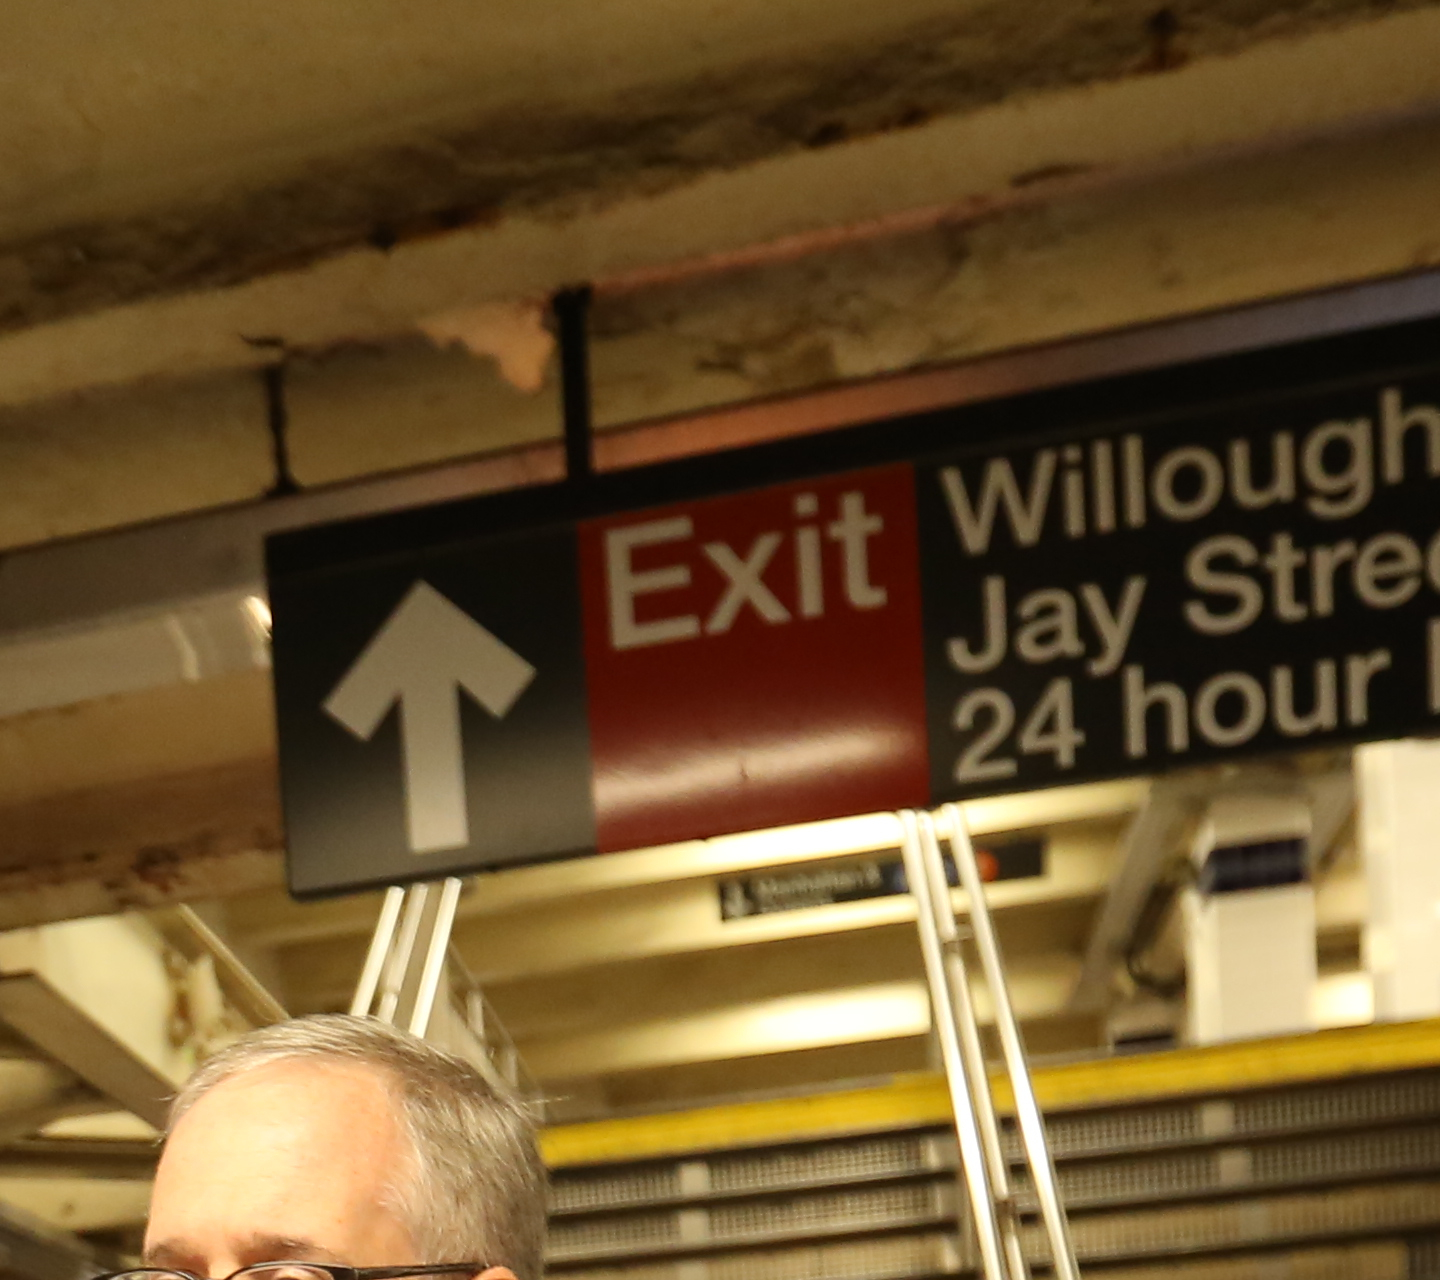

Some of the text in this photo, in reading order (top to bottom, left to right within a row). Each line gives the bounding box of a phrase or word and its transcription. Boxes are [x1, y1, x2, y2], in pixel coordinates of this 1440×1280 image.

[603, 490, 889, 652] Exit
[946, 574, 1147, 676] Jay
[950, 677, 1086, 786] 24
[1122, 648, 1392, 760] hour
